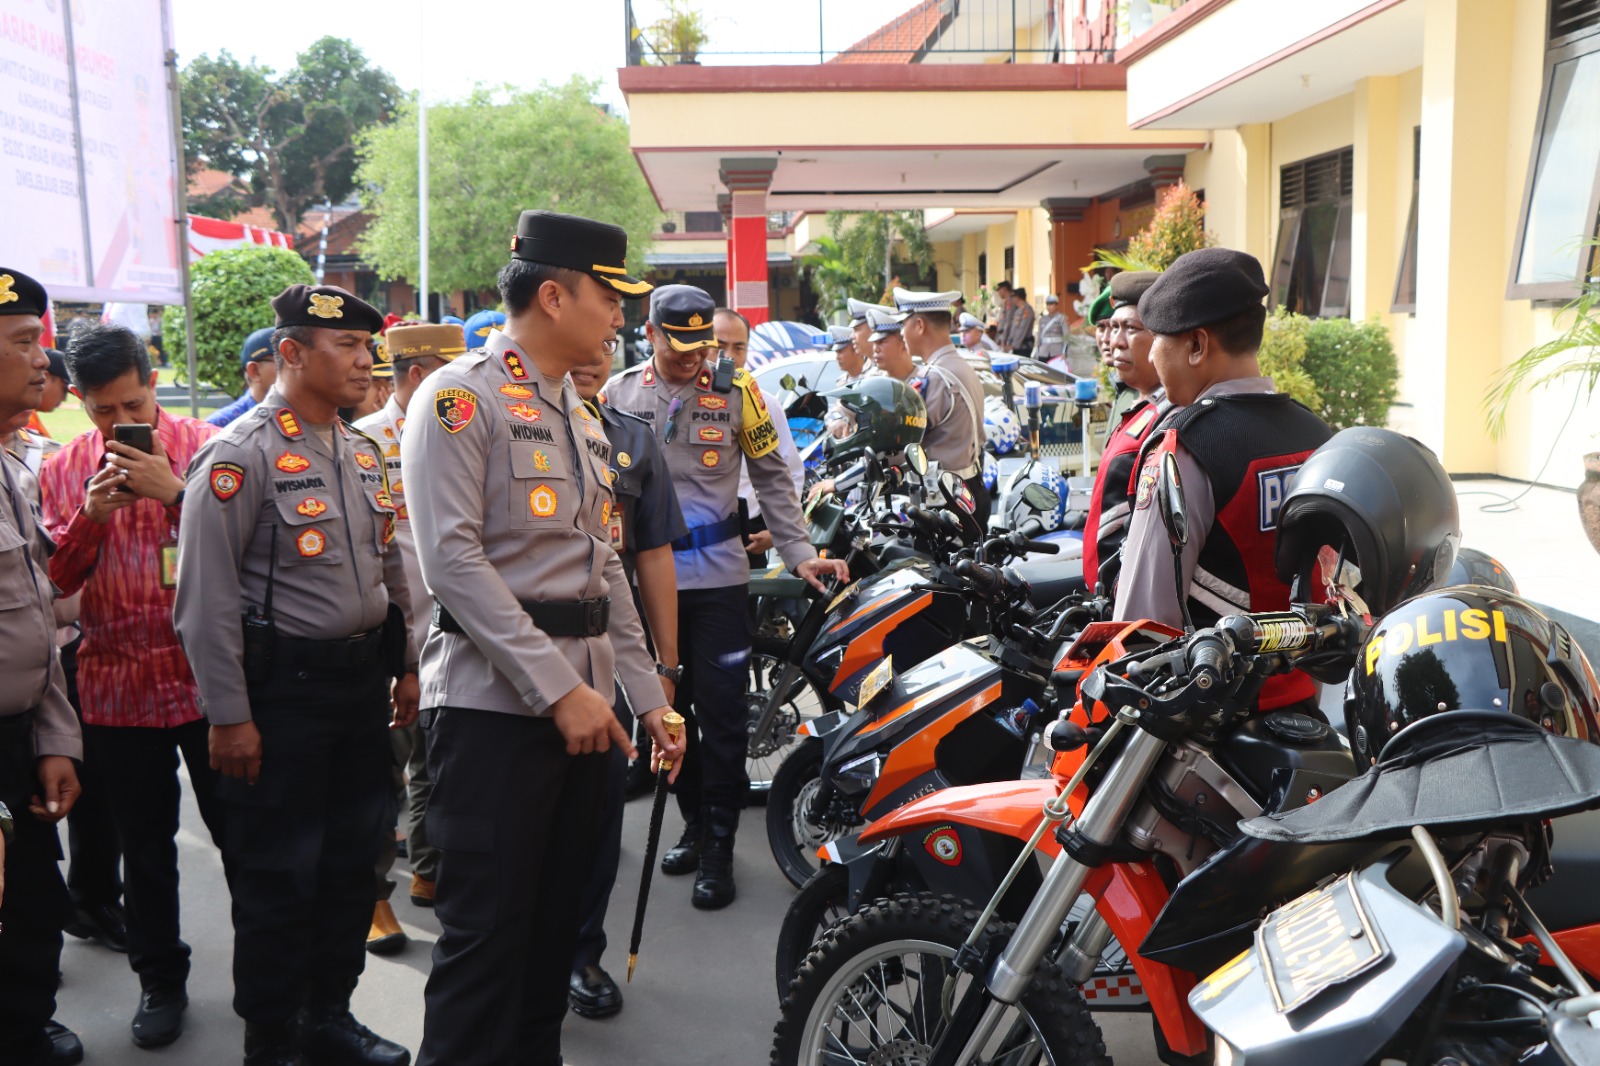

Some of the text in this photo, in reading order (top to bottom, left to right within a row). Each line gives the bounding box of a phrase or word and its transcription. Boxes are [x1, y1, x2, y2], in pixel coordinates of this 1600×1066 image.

[692, 411, 731, 422] POLRI
[509, 423, 554, 442] WIDWAN
[585, 438, 609, 462] POLRI
[1365, 608, 1508, 677] POLISI
